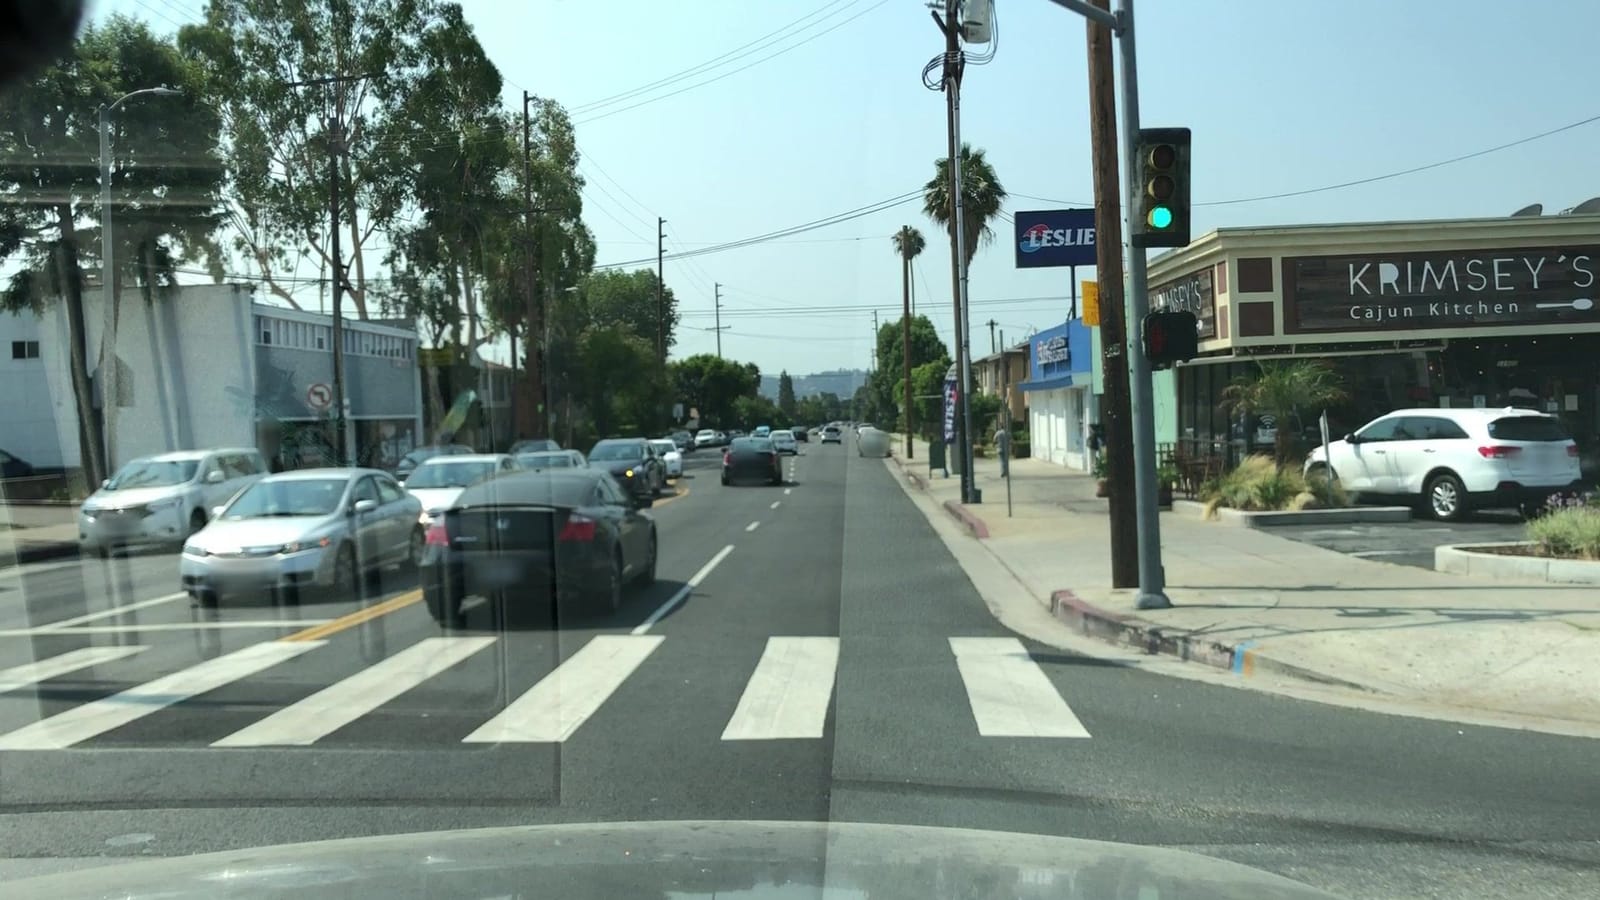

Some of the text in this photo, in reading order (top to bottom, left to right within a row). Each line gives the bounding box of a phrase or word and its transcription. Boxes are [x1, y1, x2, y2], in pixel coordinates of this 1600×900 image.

[1349, 255, 1594, 295] KRIMSEY'S
[1350, 301, 1519, 321] Cajun Kitchen
